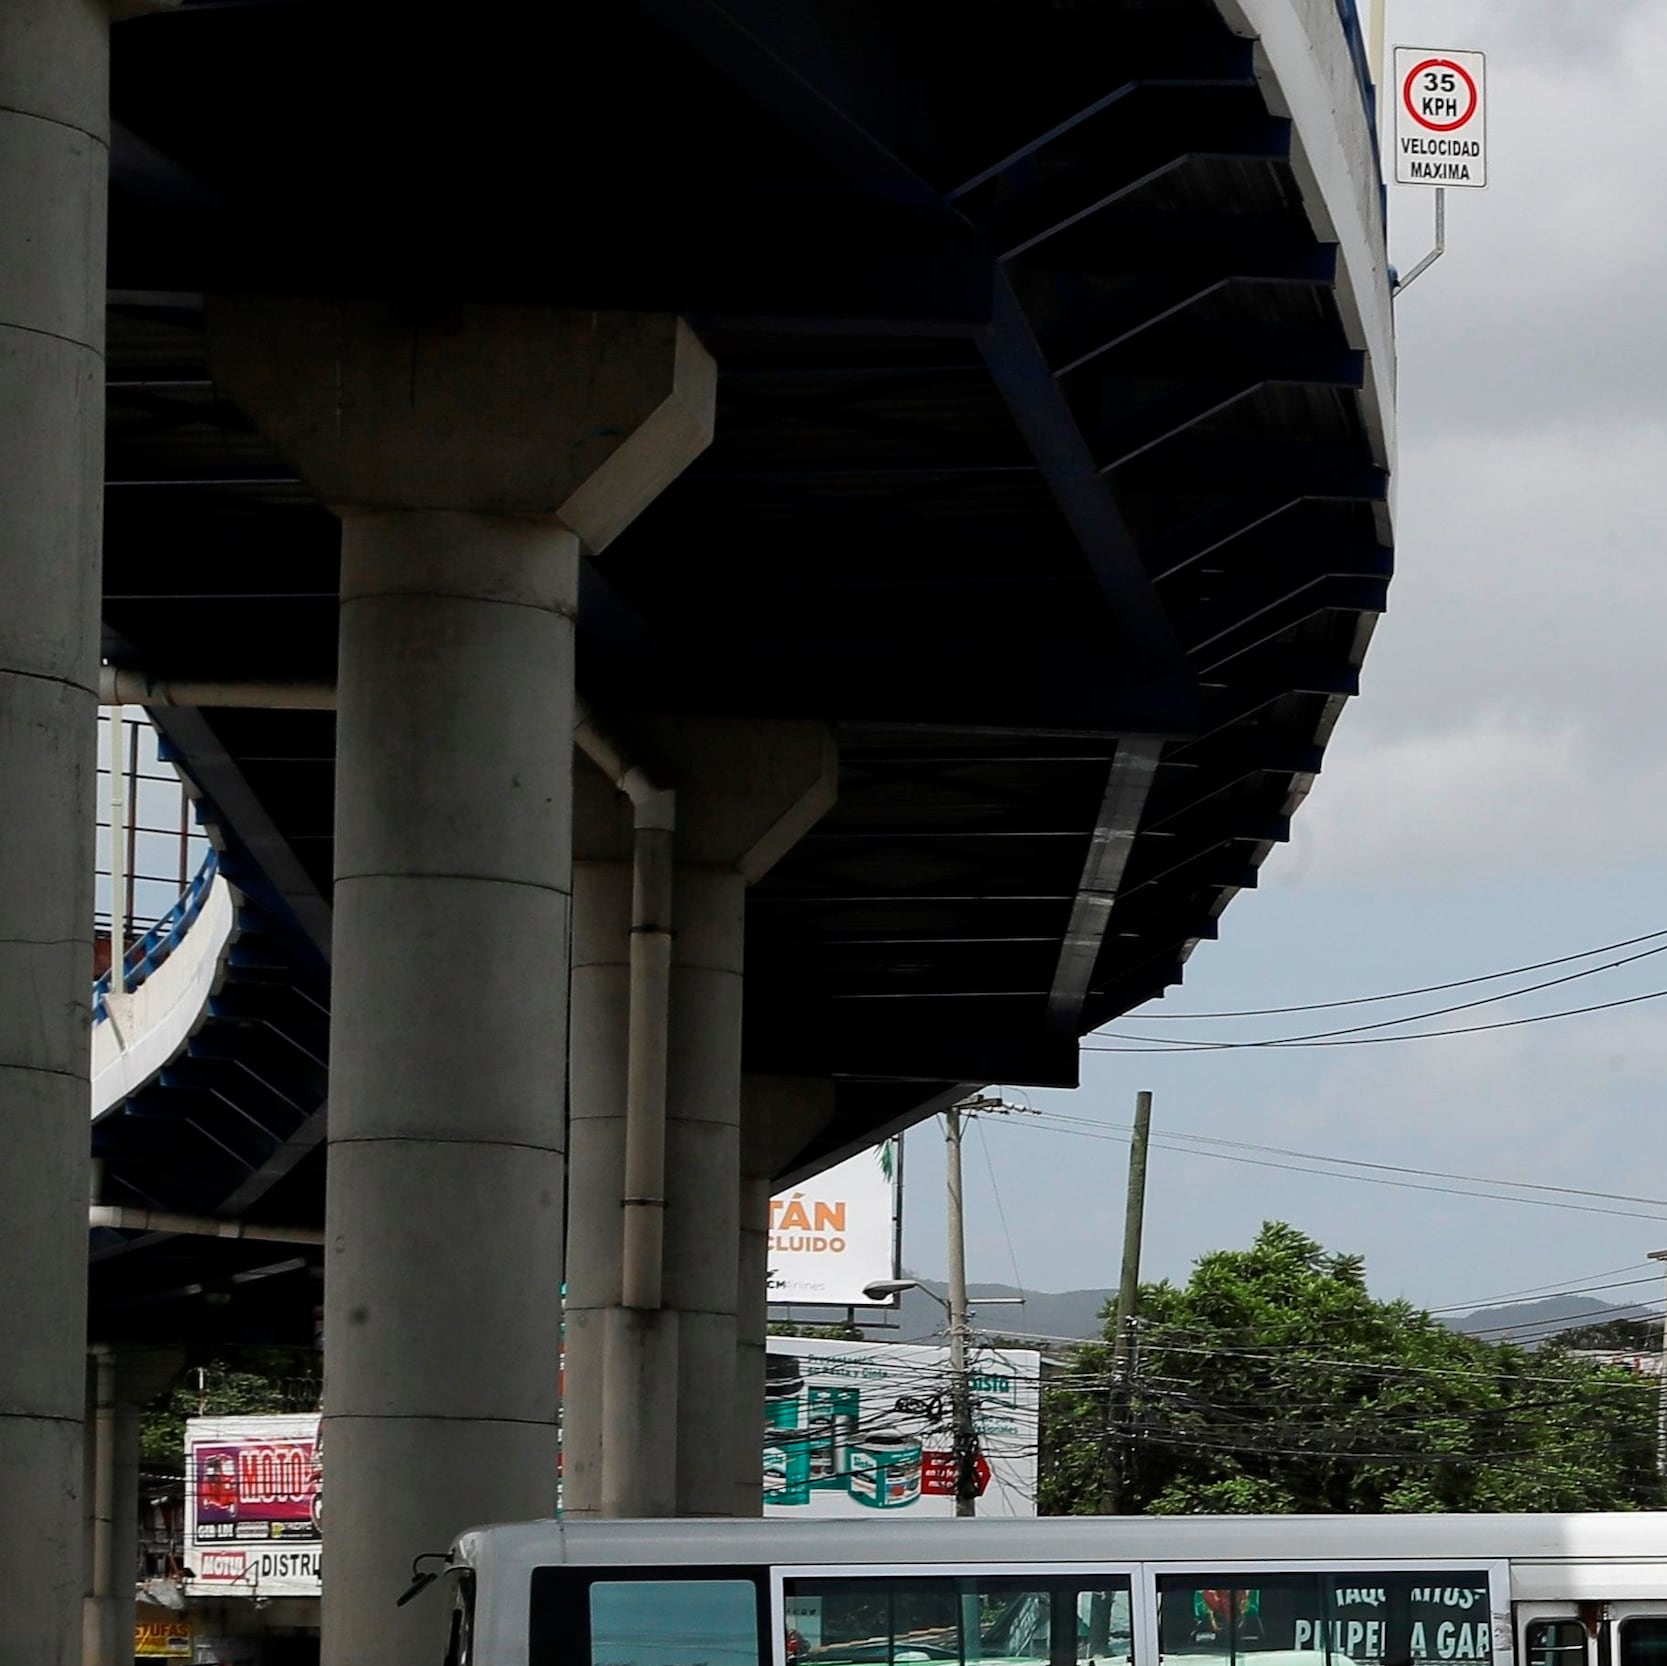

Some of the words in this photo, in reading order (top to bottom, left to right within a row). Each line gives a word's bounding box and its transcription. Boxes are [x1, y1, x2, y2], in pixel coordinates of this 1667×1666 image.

[1423, 72, 1456, 93] 35
[1422, 97, 1457, 117] KPH
[1401, 138, 1481, 157] VELOCIDAD
[1411, 162, 1470, 180] MAXIMA
[768, 1192, 846, 1231] TÁN
[239, 1450, 305, 1503] MOTO
[203, 1556, 245, 1576] MOTUL
